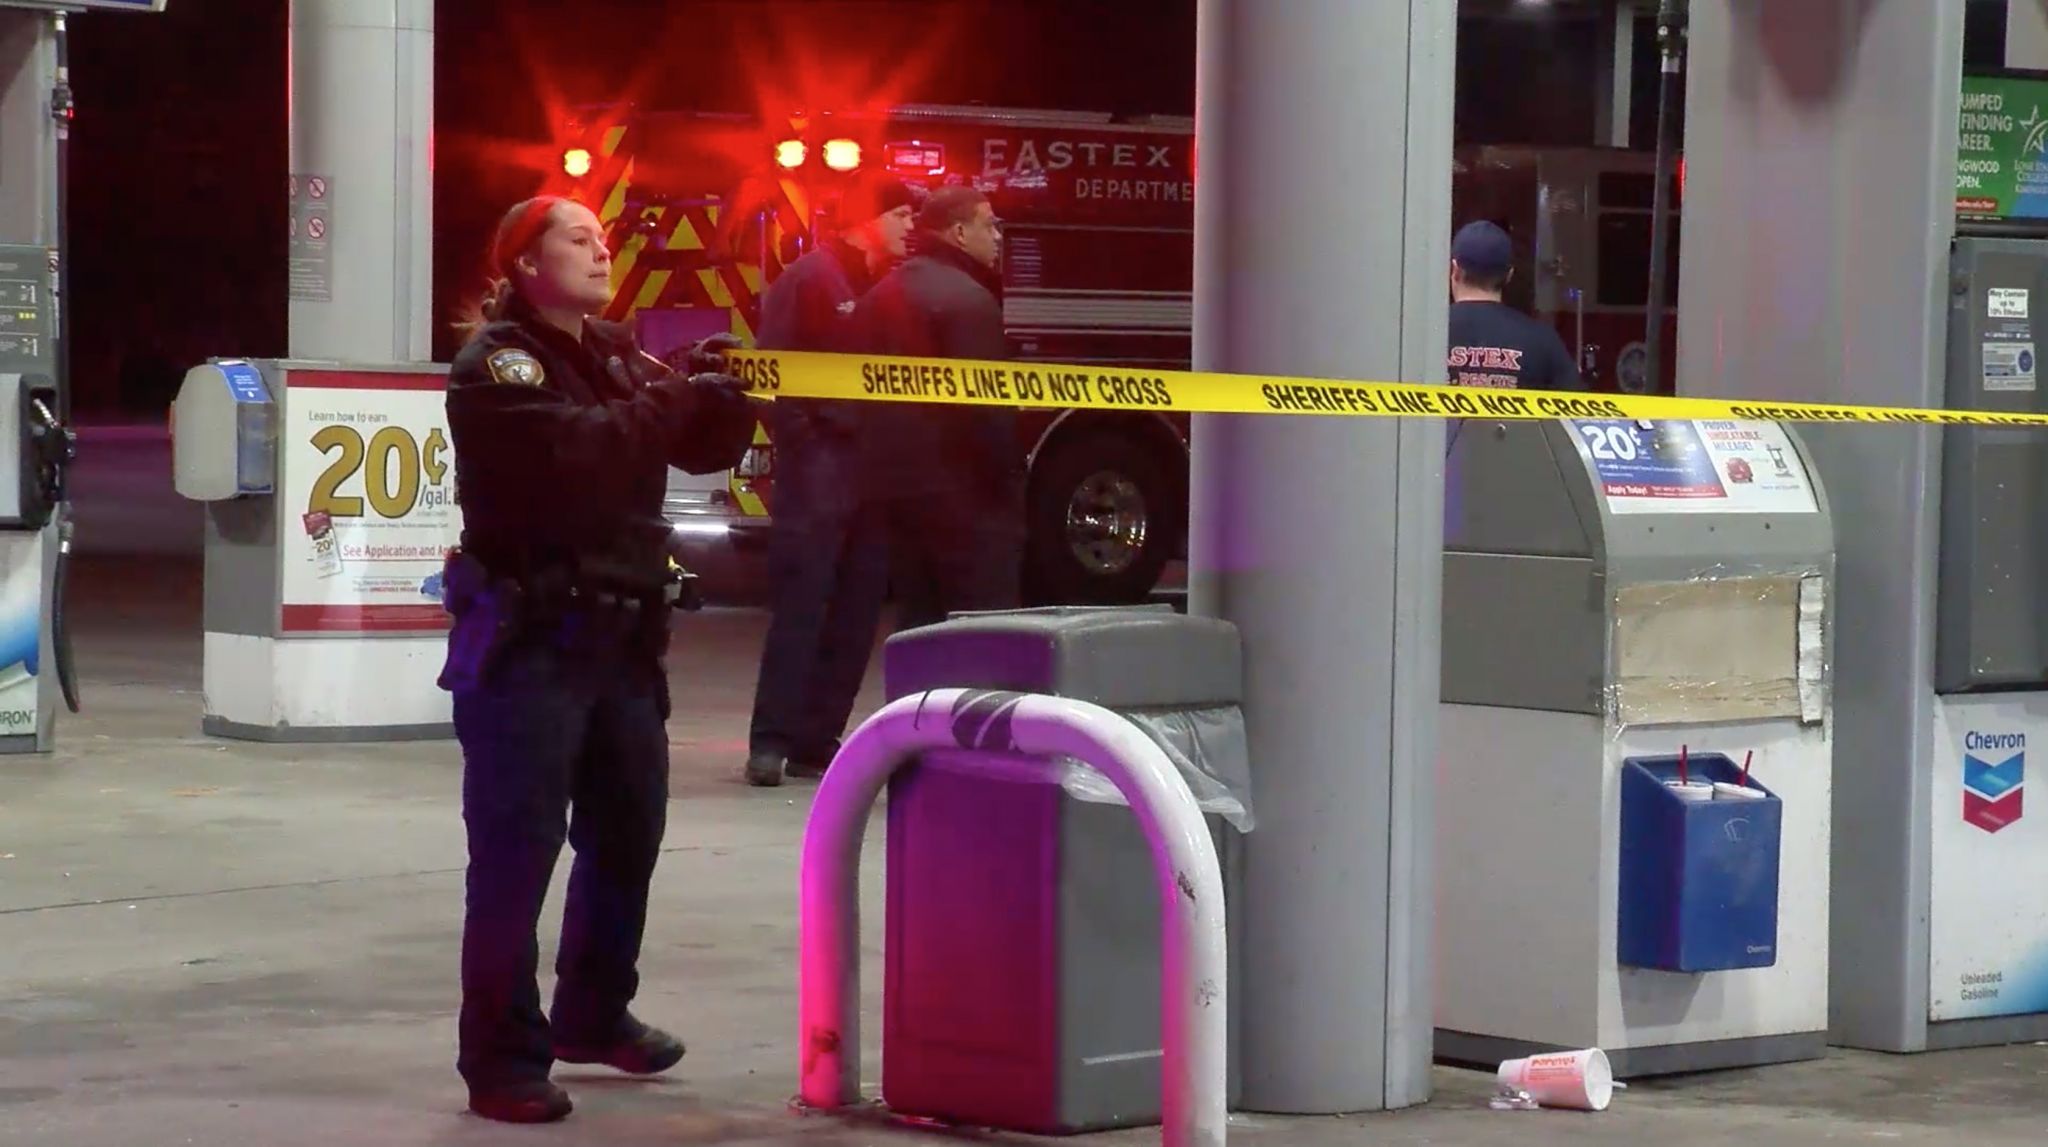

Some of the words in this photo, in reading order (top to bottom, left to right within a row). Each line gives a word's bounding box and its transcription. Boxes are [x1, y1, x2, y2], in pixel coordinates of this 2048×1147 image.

[1961, 114, 2014, 132] FINDING
[983, 138, 1171, 178] EASTEX
[1075, 177, 1192, 201] DEPARTME
[1447, 346, 1522, 370] STEX
[729, 358, 780, 390] ROSS
[862, 363, 957, 397] SHERIFFS
[961, 368, 1011, 399] LINE
[1012, 371, 1044, 400] DO
[1047, 372, 1092, 402] NOT
[1097, 375, 1173, 405] CROSS
[1262, 383, 1378, 412] SHERIFFS
[1377, 389, 1439, 413] LINE
[1437, 392, 1478, 415] DO
[1476, 394, 1536, 417] NOT
[1531, 397, 1627, 418] CROSS
[308, 410, 335, 421] Learn
[336, 411, 355, 422] how
[356, 412, 367, 422] to
[367, 413, 388, 422] earn
[308, 424, 449, 519] 20¢
[343, 544, 362, 557] See
[364, 544, 418, 558] Application
[419, 545, 436, 557] and
[1965, 731, 2026, 750] Chevron
[1960, 971, 2003, 985] Unleaded
[1960, 987, 1999, 1001] Gasoline
